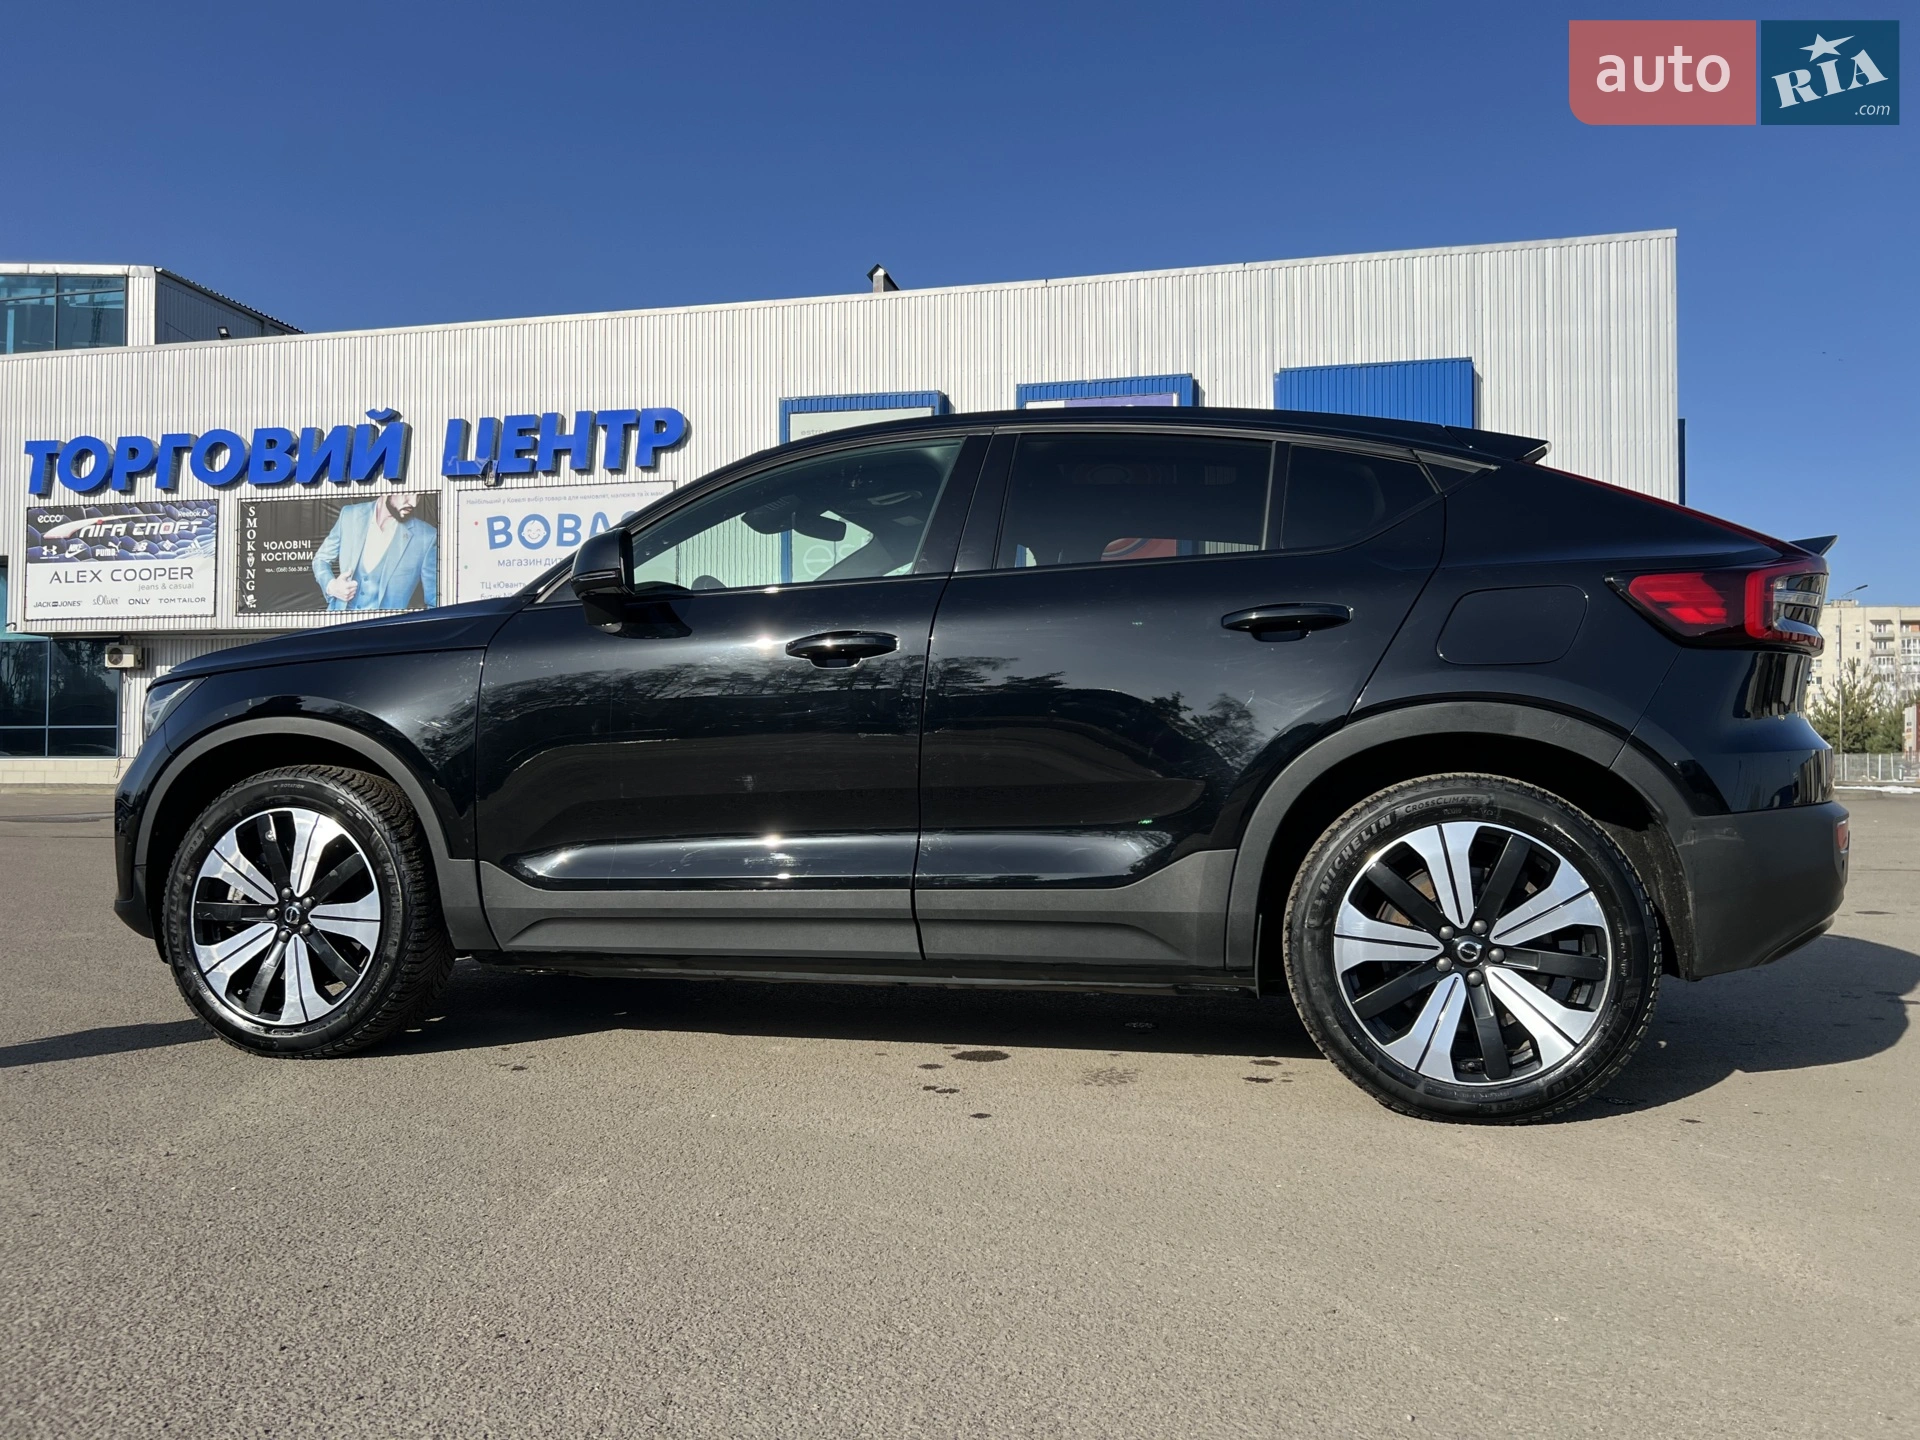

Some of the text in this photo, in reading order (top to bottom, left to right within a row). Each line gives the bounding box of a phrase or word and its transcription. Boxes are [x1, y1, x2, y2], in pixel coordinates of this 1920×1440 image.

[24, 407, 688, 496] ТОРГОВИЙ ЦЕНТР
[37, 514, 62, 523] ecco
[263, 540, 311, 551] ЧОЛОВІЧІ
[261, 551, 314, 562] КОСТЮМИ
[497, 559, 542, 567] магазин
[49, 567, 194, 584] ALEX COOPER
[138, 584, 159, 592] jeans
[168, 582, 194, 590] casual
[480, 582, 492, 590] ТЦ
[128, 598, 151, 606] ONLY
[1319, 814, 1392, 895] MICHELIN
[169, 881, 185, 968] MICHELIN
